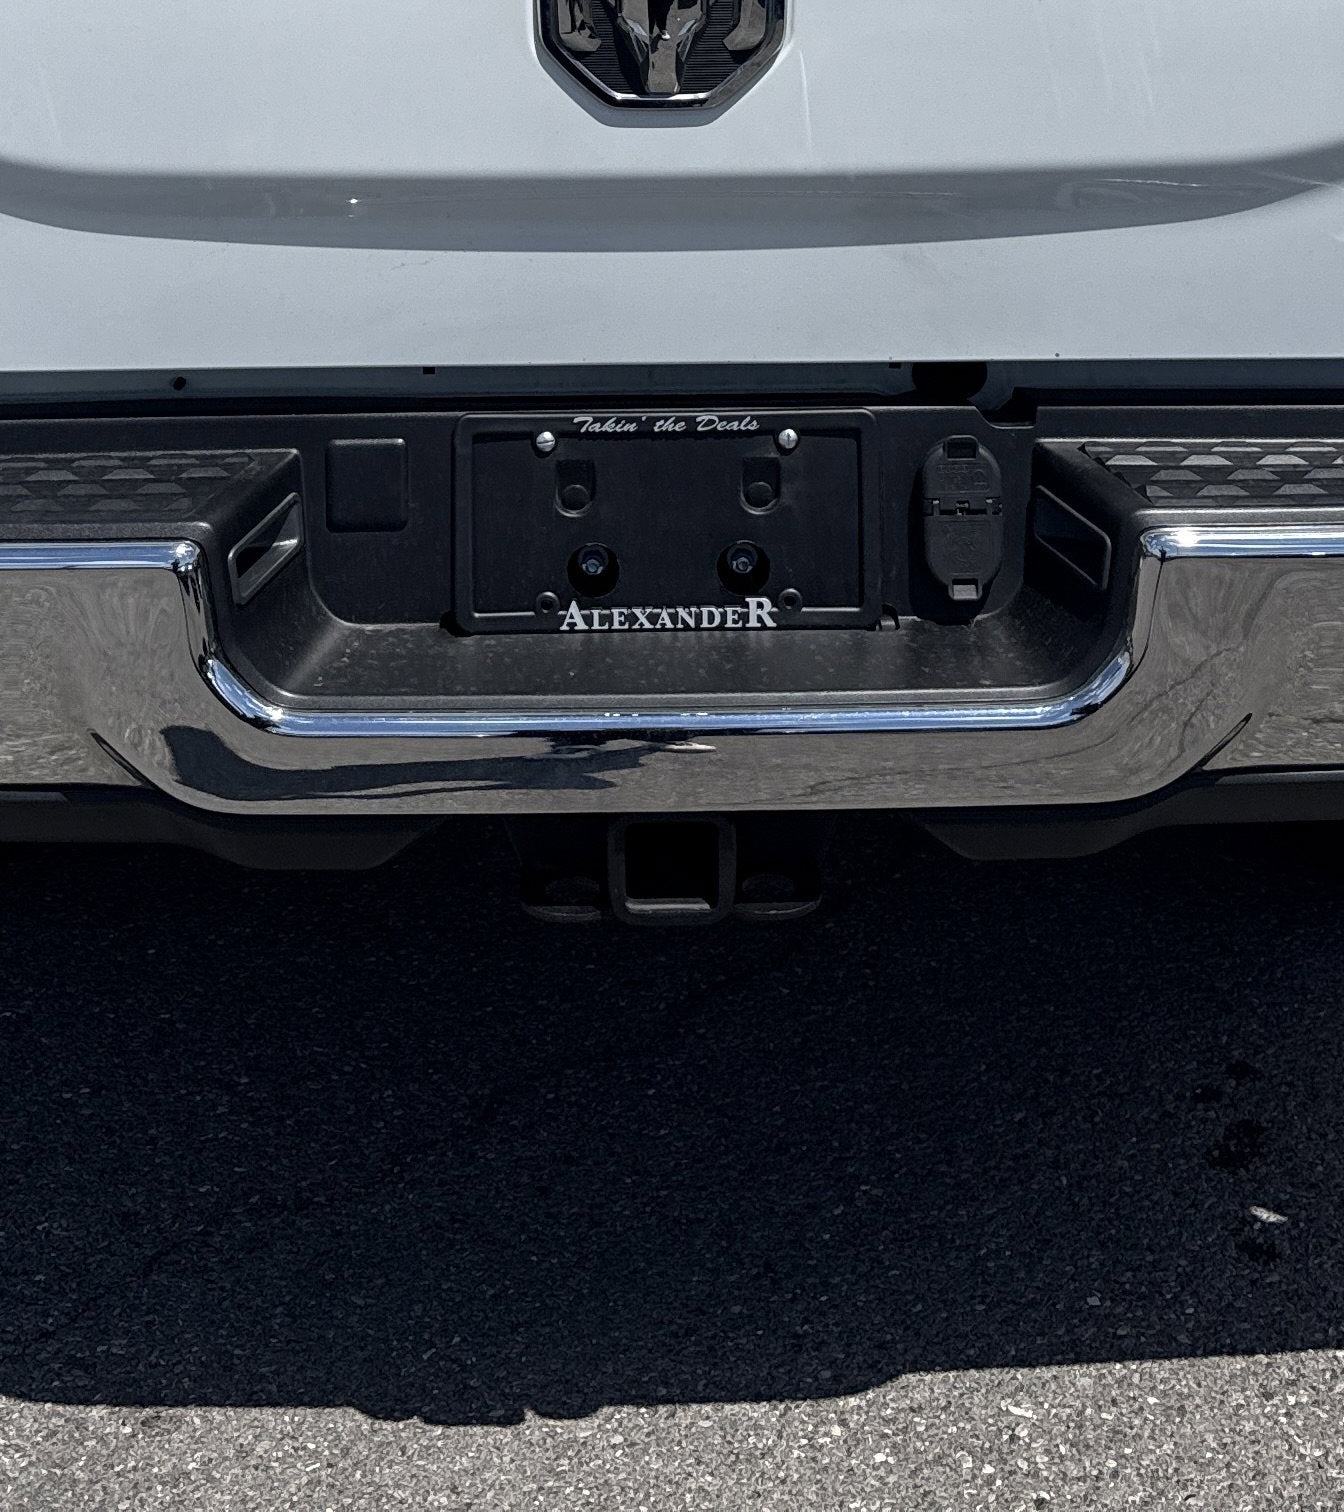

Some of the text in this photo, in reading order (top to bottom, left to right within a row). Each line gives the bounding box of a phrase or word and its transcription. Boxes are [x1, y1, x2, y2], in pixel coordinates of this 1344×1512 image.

[573, 415, 761, 433] Takin' the Deals
[559, 597, 777, 630] ALEXANDER
